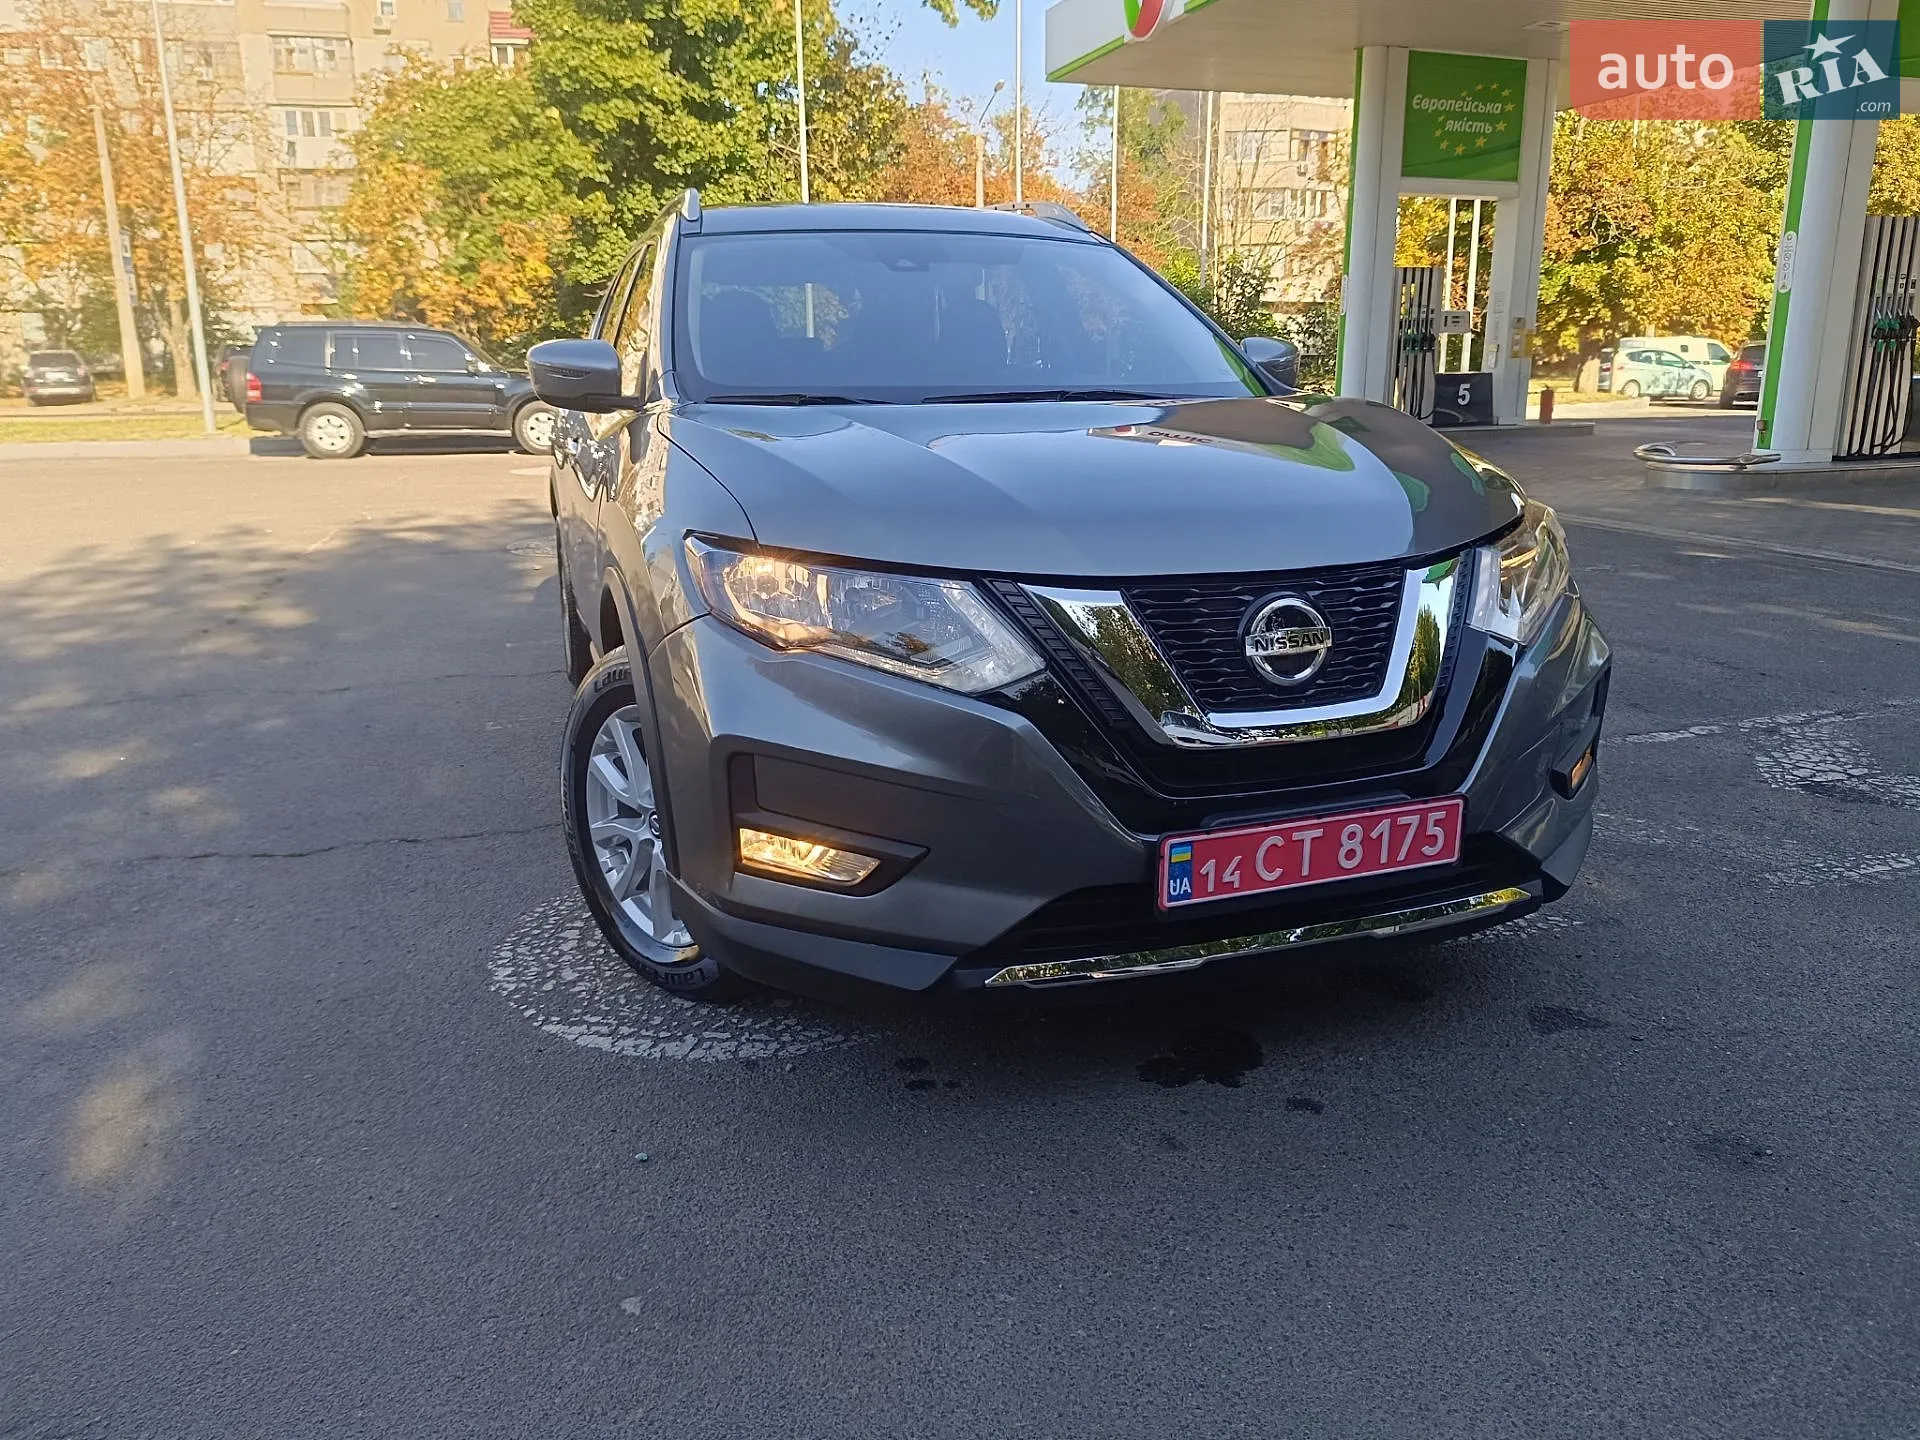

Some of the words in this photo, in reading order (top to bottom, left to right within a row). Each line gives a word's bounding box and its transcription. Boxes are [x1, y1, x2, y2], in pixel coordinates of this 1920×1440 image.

[1412, 94, 1503, 114] Європейська
[1444, 116, 1493, 134] якість
[1457, 383, 1471, 406] 5
[1254, 631, 1325, 653] NISSAN
[1200, 855, 1242, 893] 14
[1255, 828, 1324, 881] CT
[1337, 811, 1447, 869] 8175
[1170, 876, 1192, 895] UA
